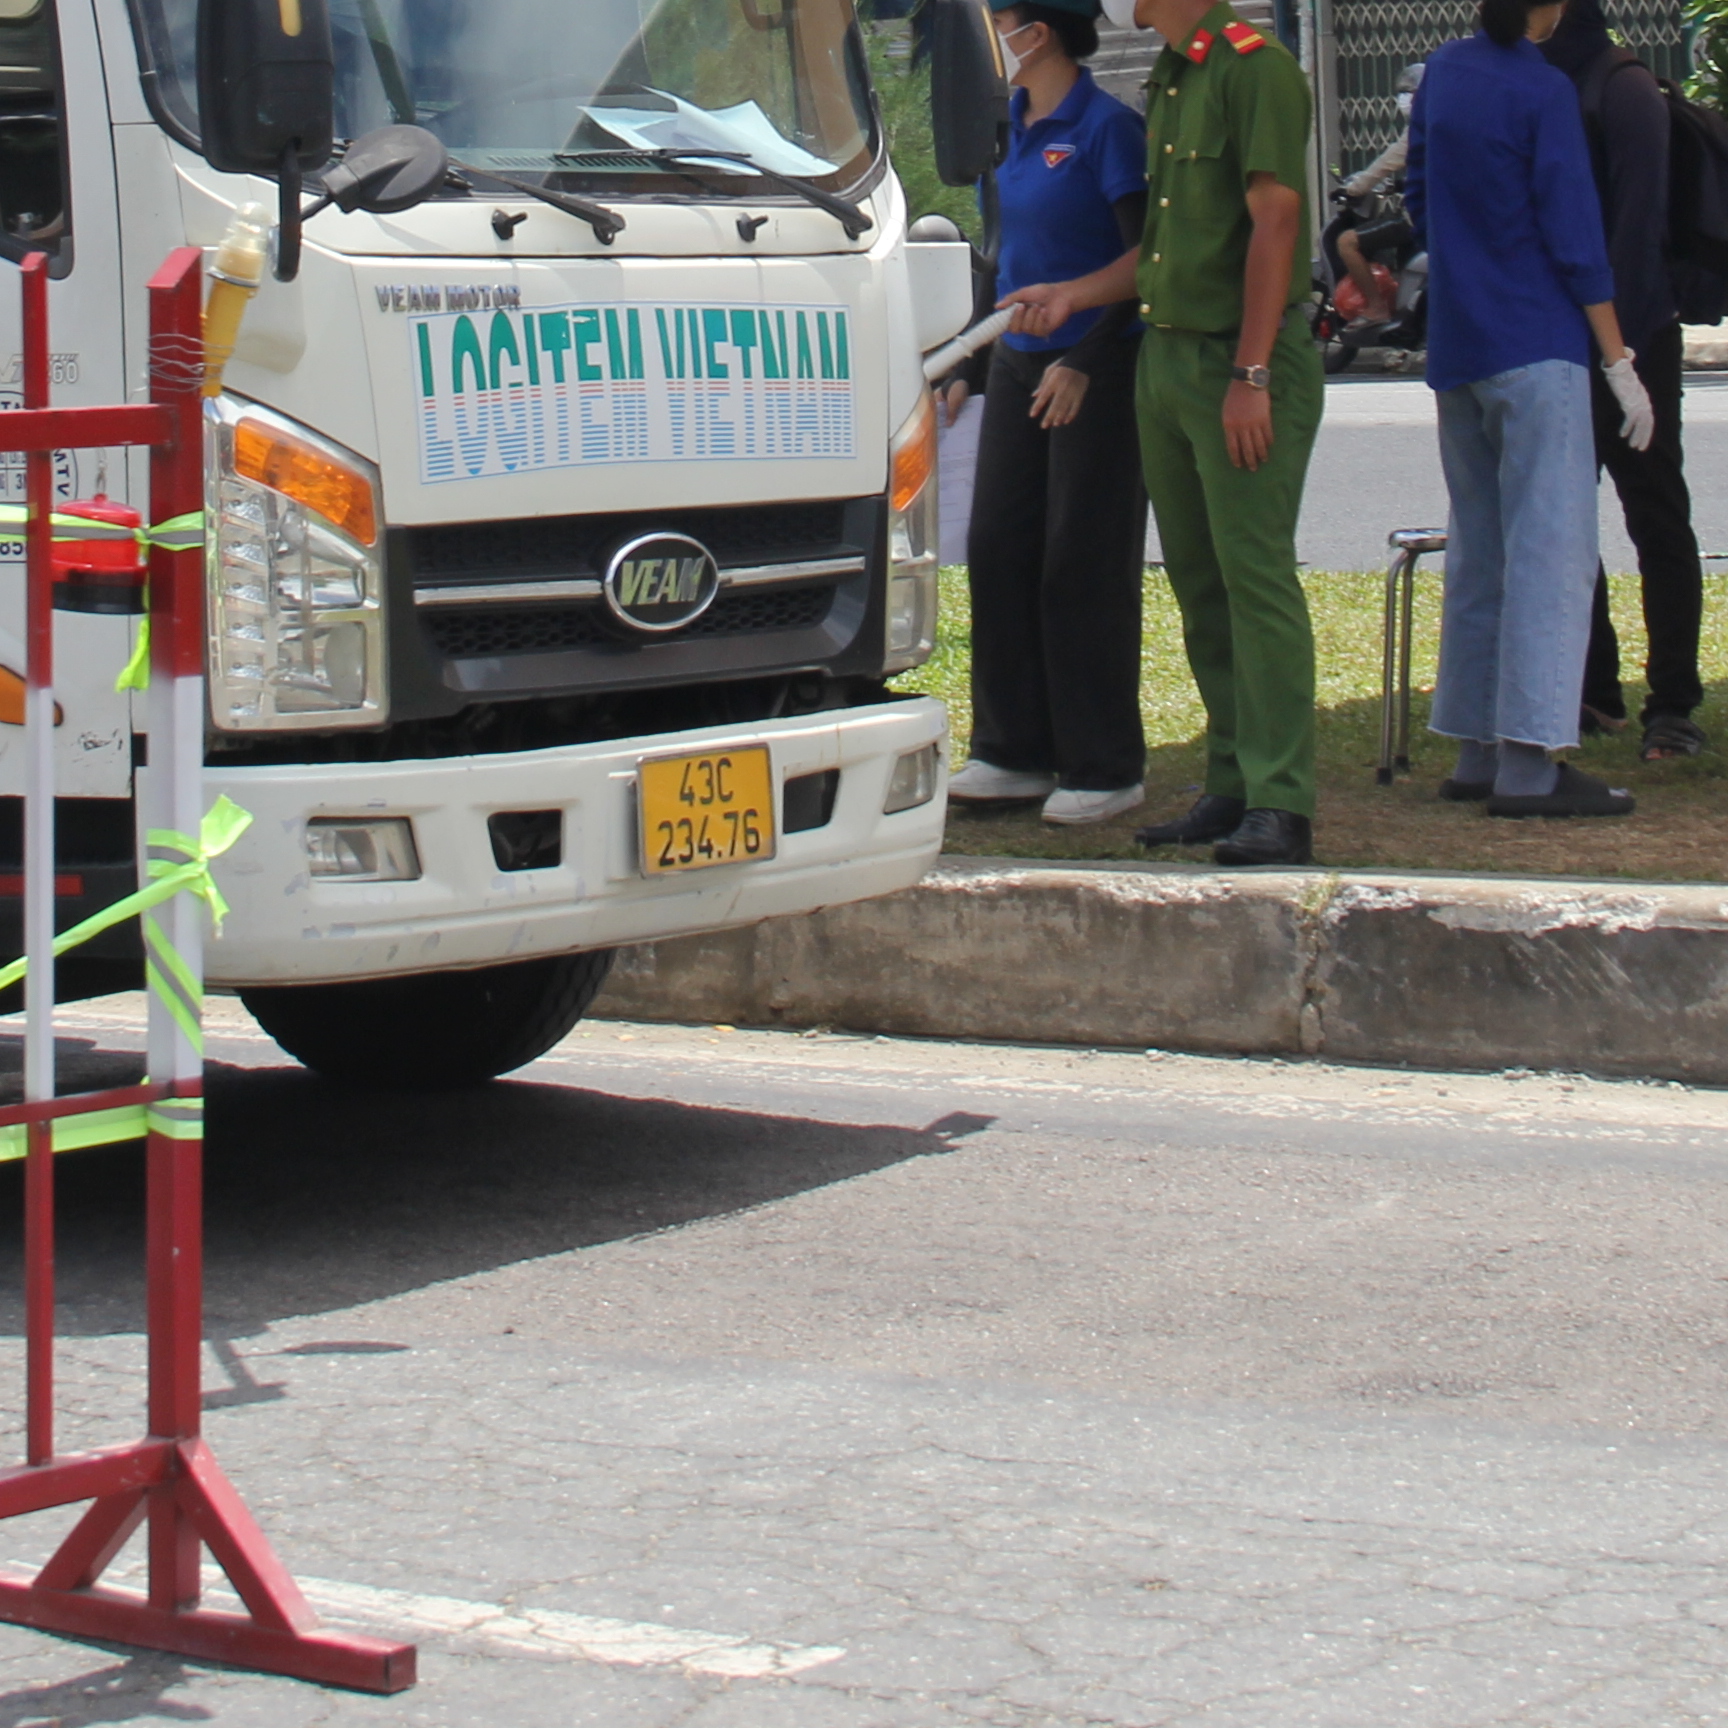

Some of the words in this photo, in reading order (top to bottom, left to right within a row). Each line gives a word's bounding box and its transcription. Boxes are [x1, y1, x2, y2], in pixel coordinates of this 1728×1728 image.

[376, 284, 441, 313] VEAM
[445, 283, 521, 312] MOTOR
[417, 308, 649, 477] LOGITEM
[655, 308, 853, 455] VIETNAM
[618, 556, 706, 606] VEAM
[679, 757, 734, 807] 43C
[658, 809, 761, 867] 234.76
